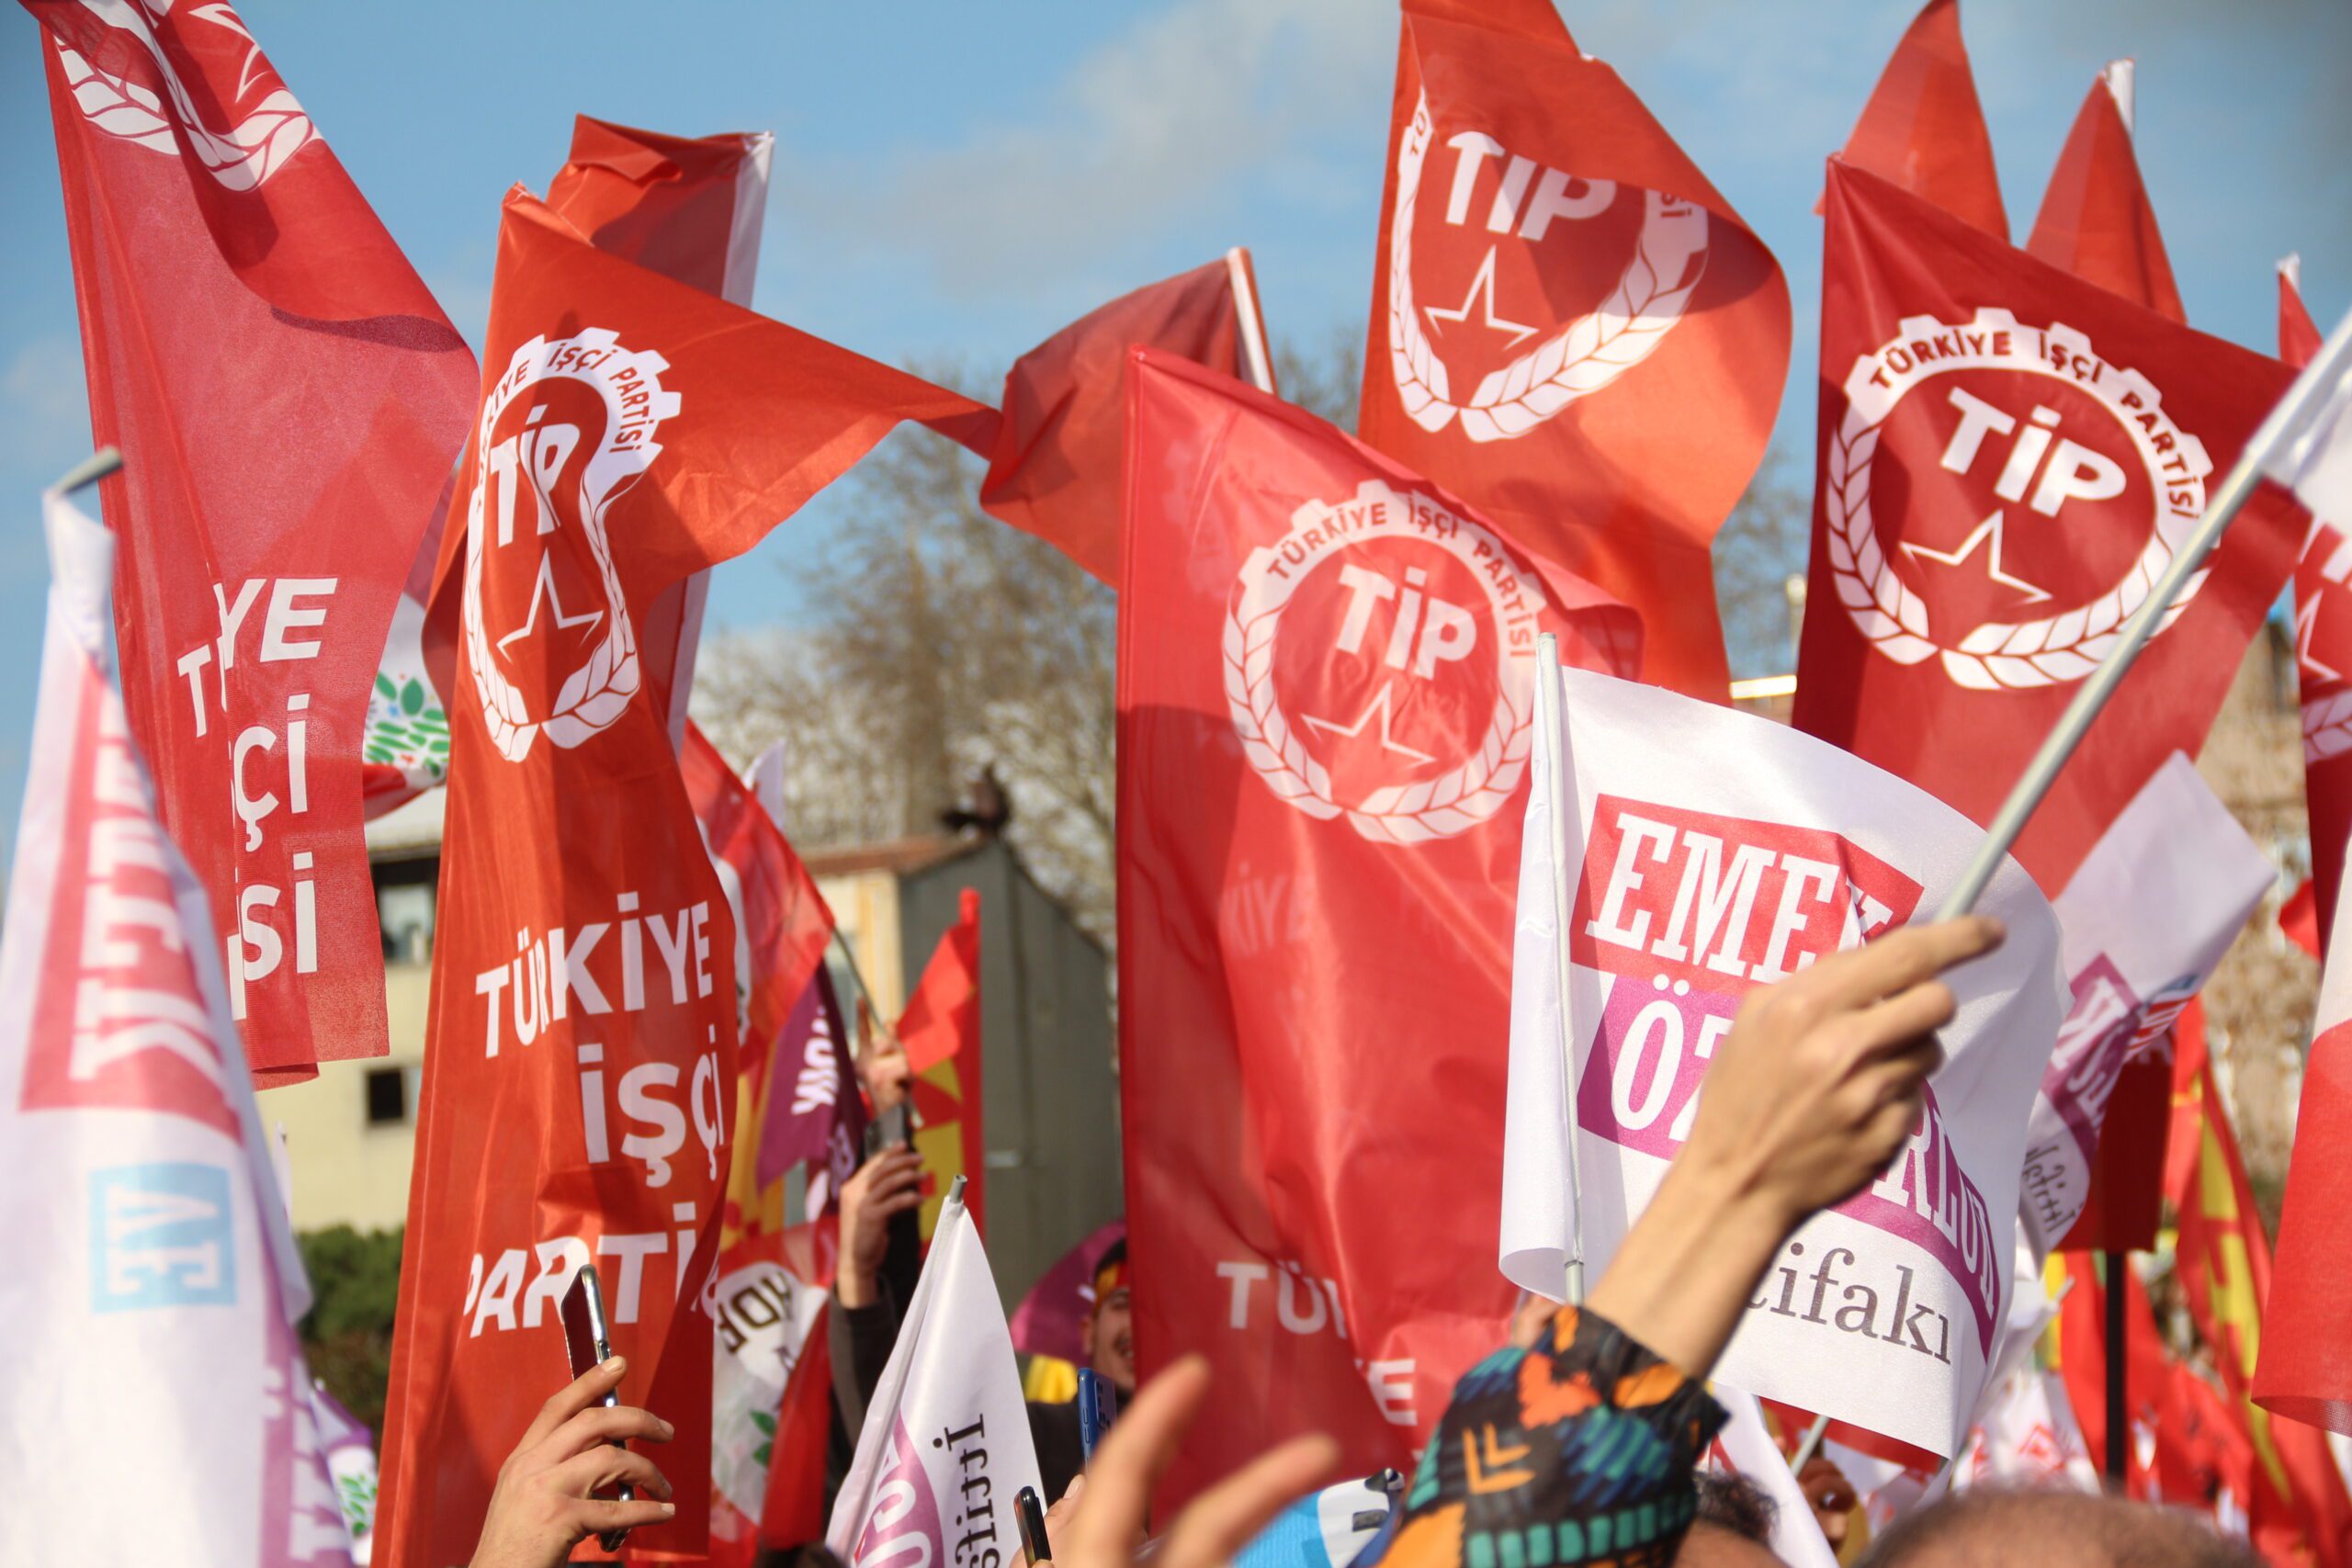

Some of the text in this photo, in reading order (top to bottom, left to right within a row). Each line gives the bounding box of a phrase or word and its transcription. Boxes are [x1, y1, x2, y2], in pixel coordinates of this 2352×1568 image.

[547, 342, 618, 374] İŞÇİ
[608, 366, 661, 454] PARTİSİ
[1869, 327, 2199, 521] TÜRKİYE İŞÇİ PARTİSİ
[1939, 385, 2128, 519] TİP
[490, 403, 581, 549] TİP
[1266, 496, 1538, 659] TÜRKİYE İŞÇİ PARTİSİ
[1336, 561, 1477, 682] TİP
[475, 889, 713, 1059] TÜRKİYE
[578, 1023, 726, 1188] İŞÇİ
